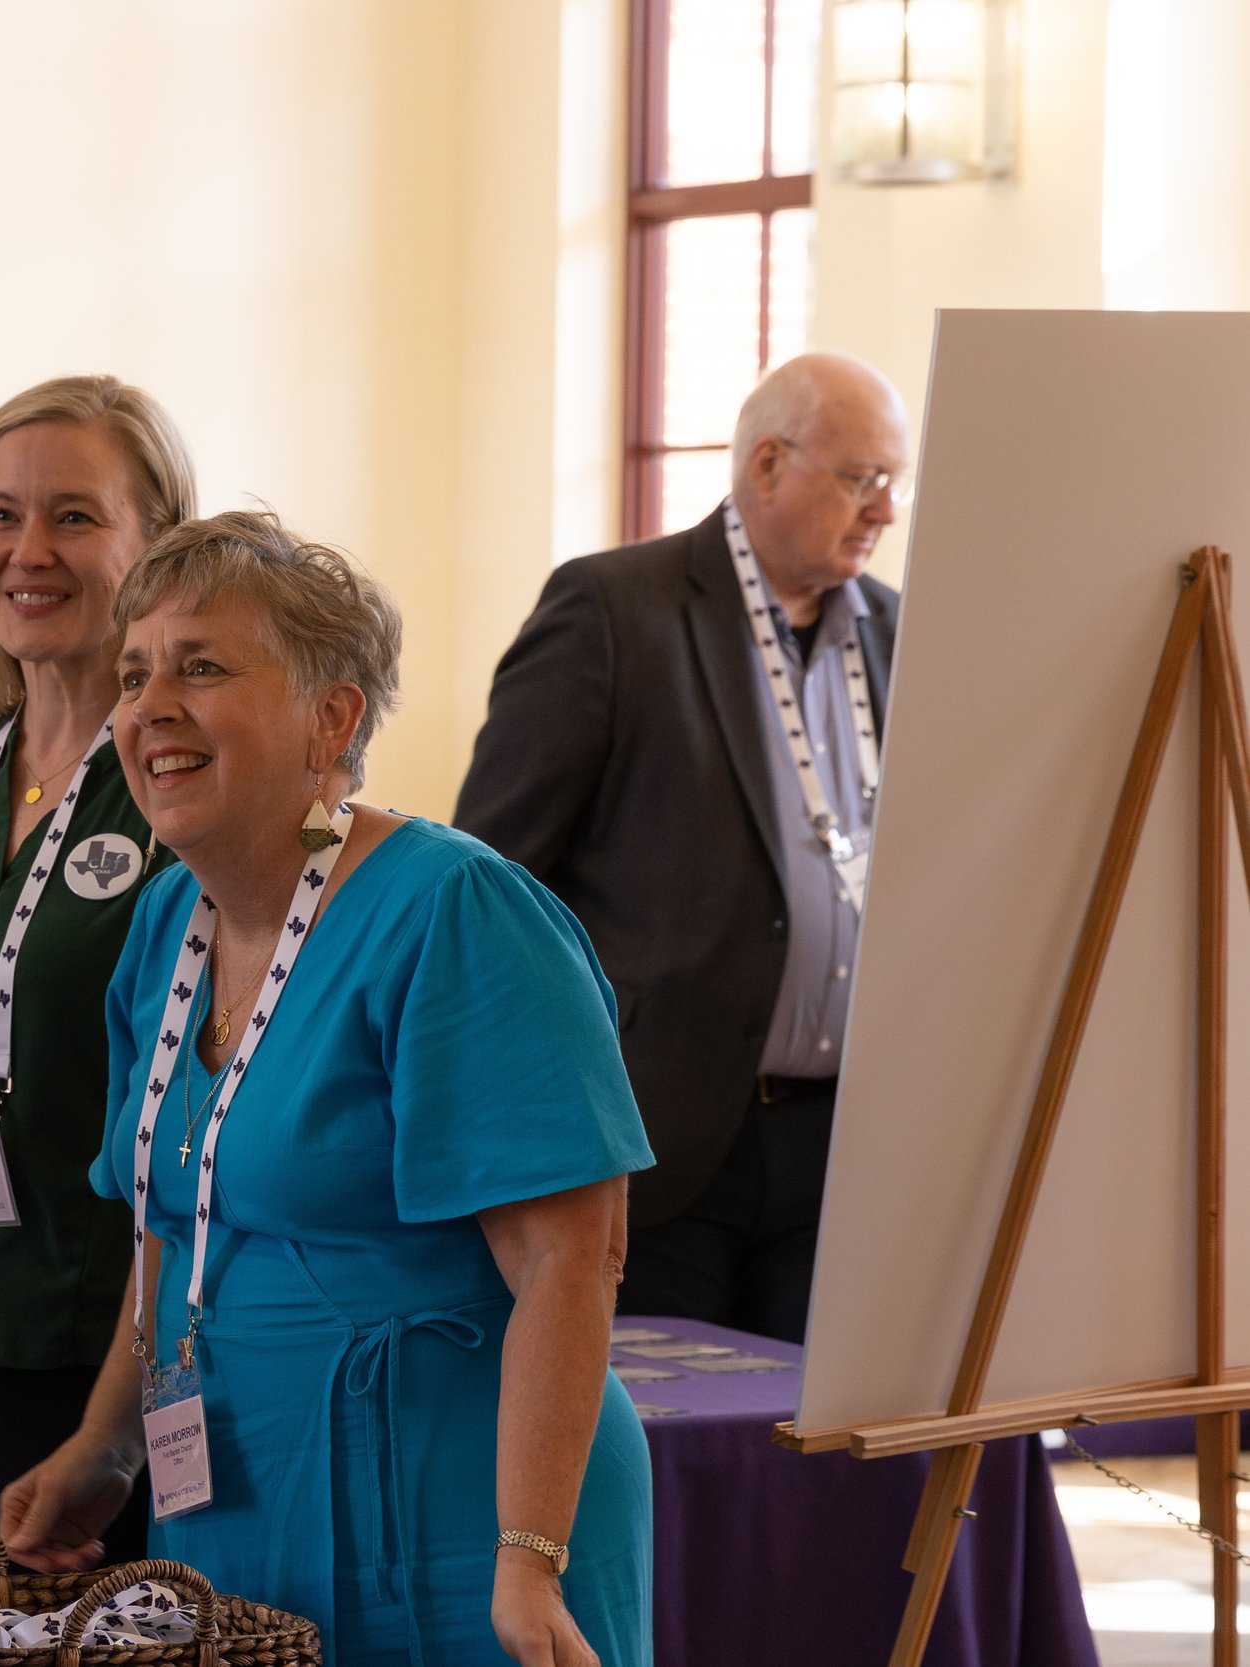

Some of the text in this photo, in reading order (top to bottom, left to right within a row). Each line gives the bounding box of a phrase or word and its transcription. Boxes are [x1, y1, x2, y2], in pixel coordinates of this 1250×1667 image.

[88, 850, 124, 873] cbf
[150, 1422, 202, 1452] KAREN MORROW
